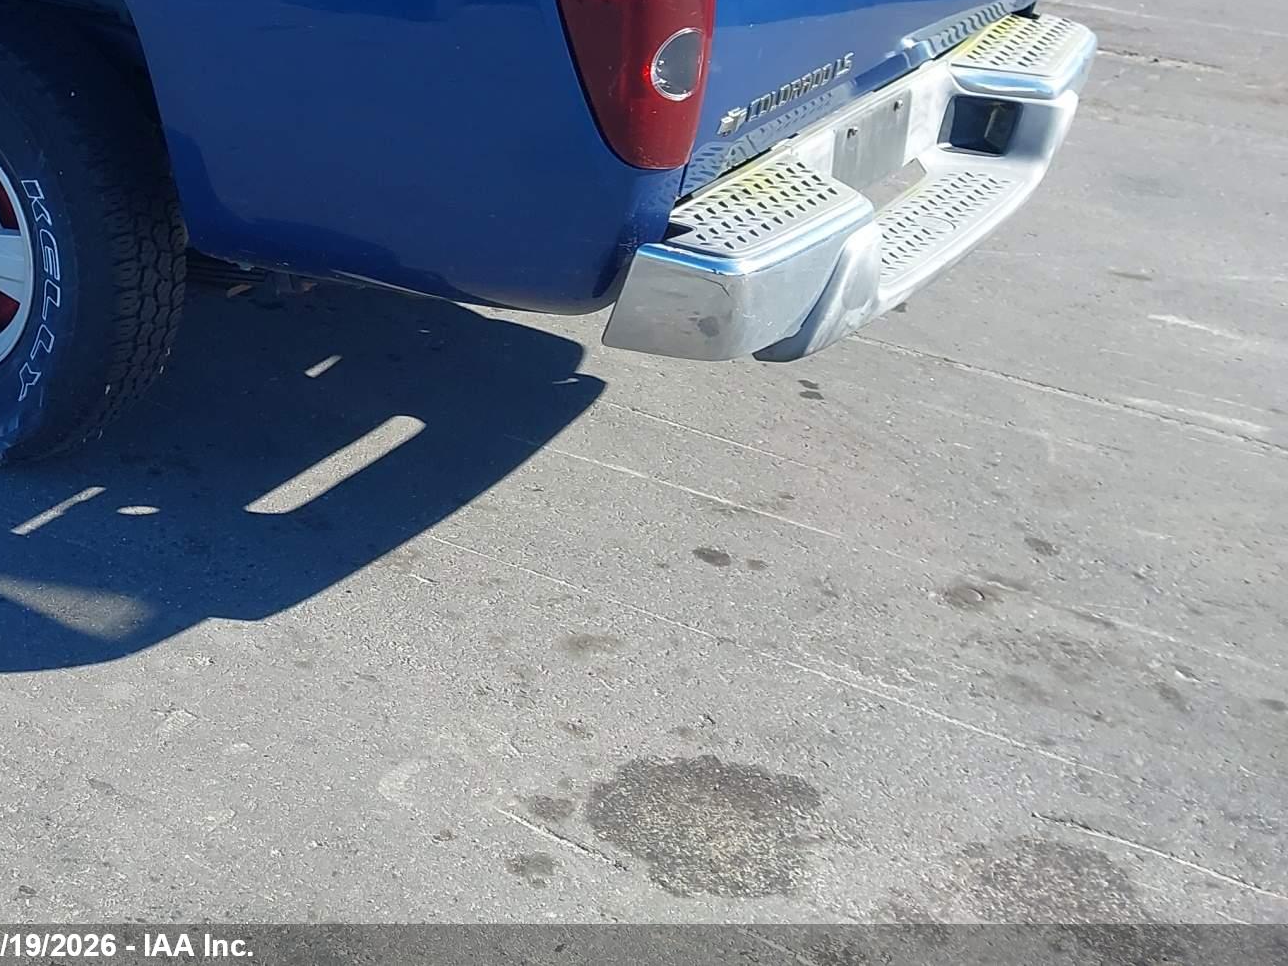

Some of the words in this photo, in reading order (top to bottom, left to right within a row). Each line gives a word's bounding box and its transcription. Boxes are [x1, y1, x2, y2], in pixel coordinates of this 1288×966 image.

[746, 63, 833, 122] COLORADO
[832, 52, 854, 79] LS
[20, 178, 61, 402] KELLY
